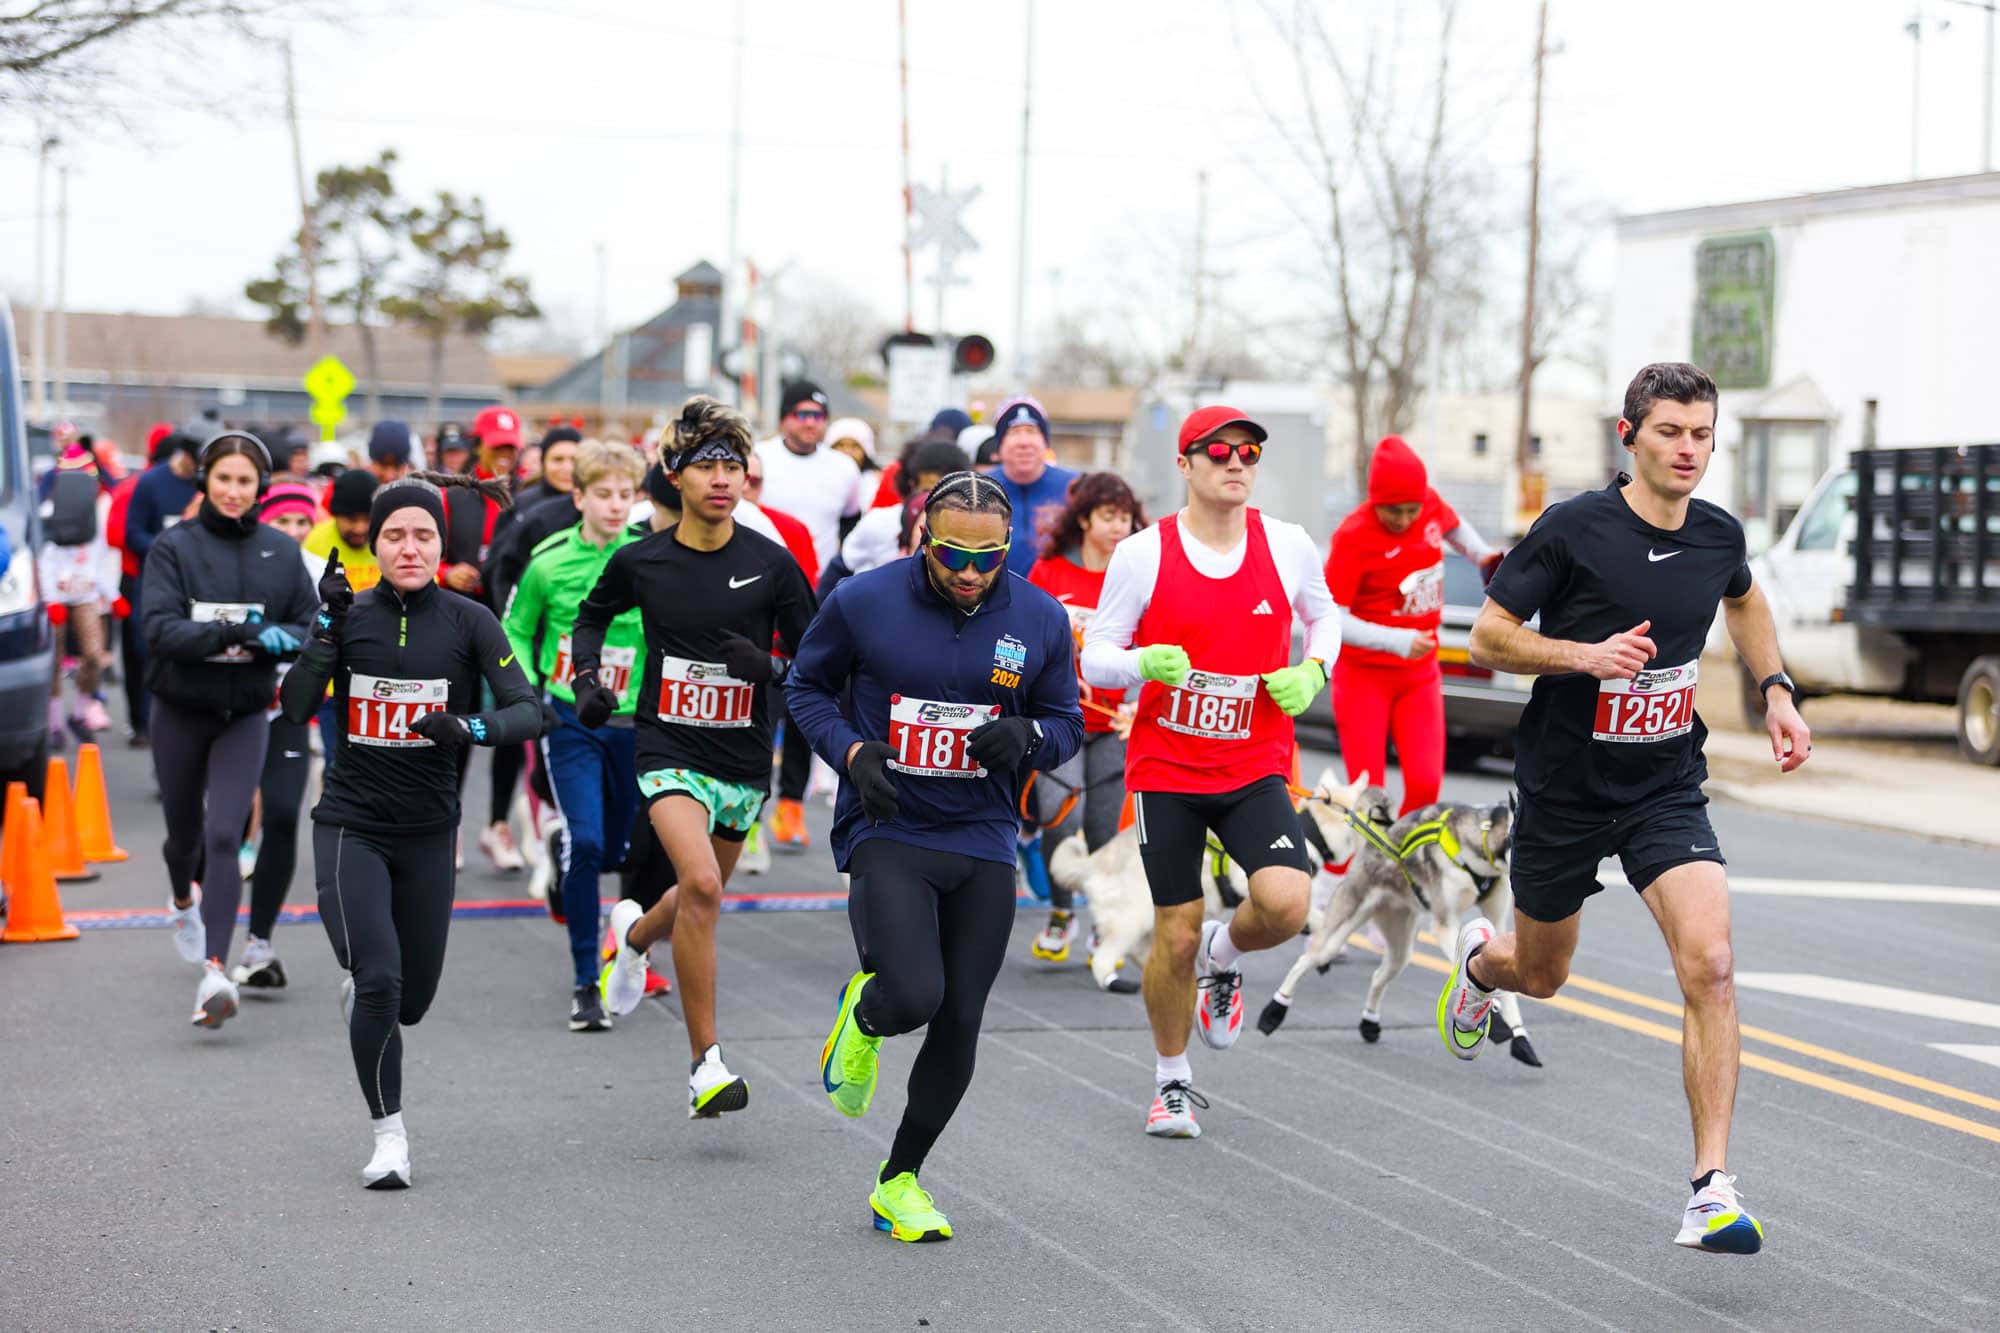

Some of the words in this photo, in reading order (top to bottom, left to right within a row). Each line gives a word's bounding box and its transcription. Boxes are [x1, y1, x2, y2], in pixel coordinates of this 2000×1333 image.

[991, 668, 1021, 688] 2024
[668, 682, 735, 721] 1301
[1169, 689, 1238, 732] 1185
[1607, 692, 1682, 734] 1252
[898, 726, 972, 769] 1181
